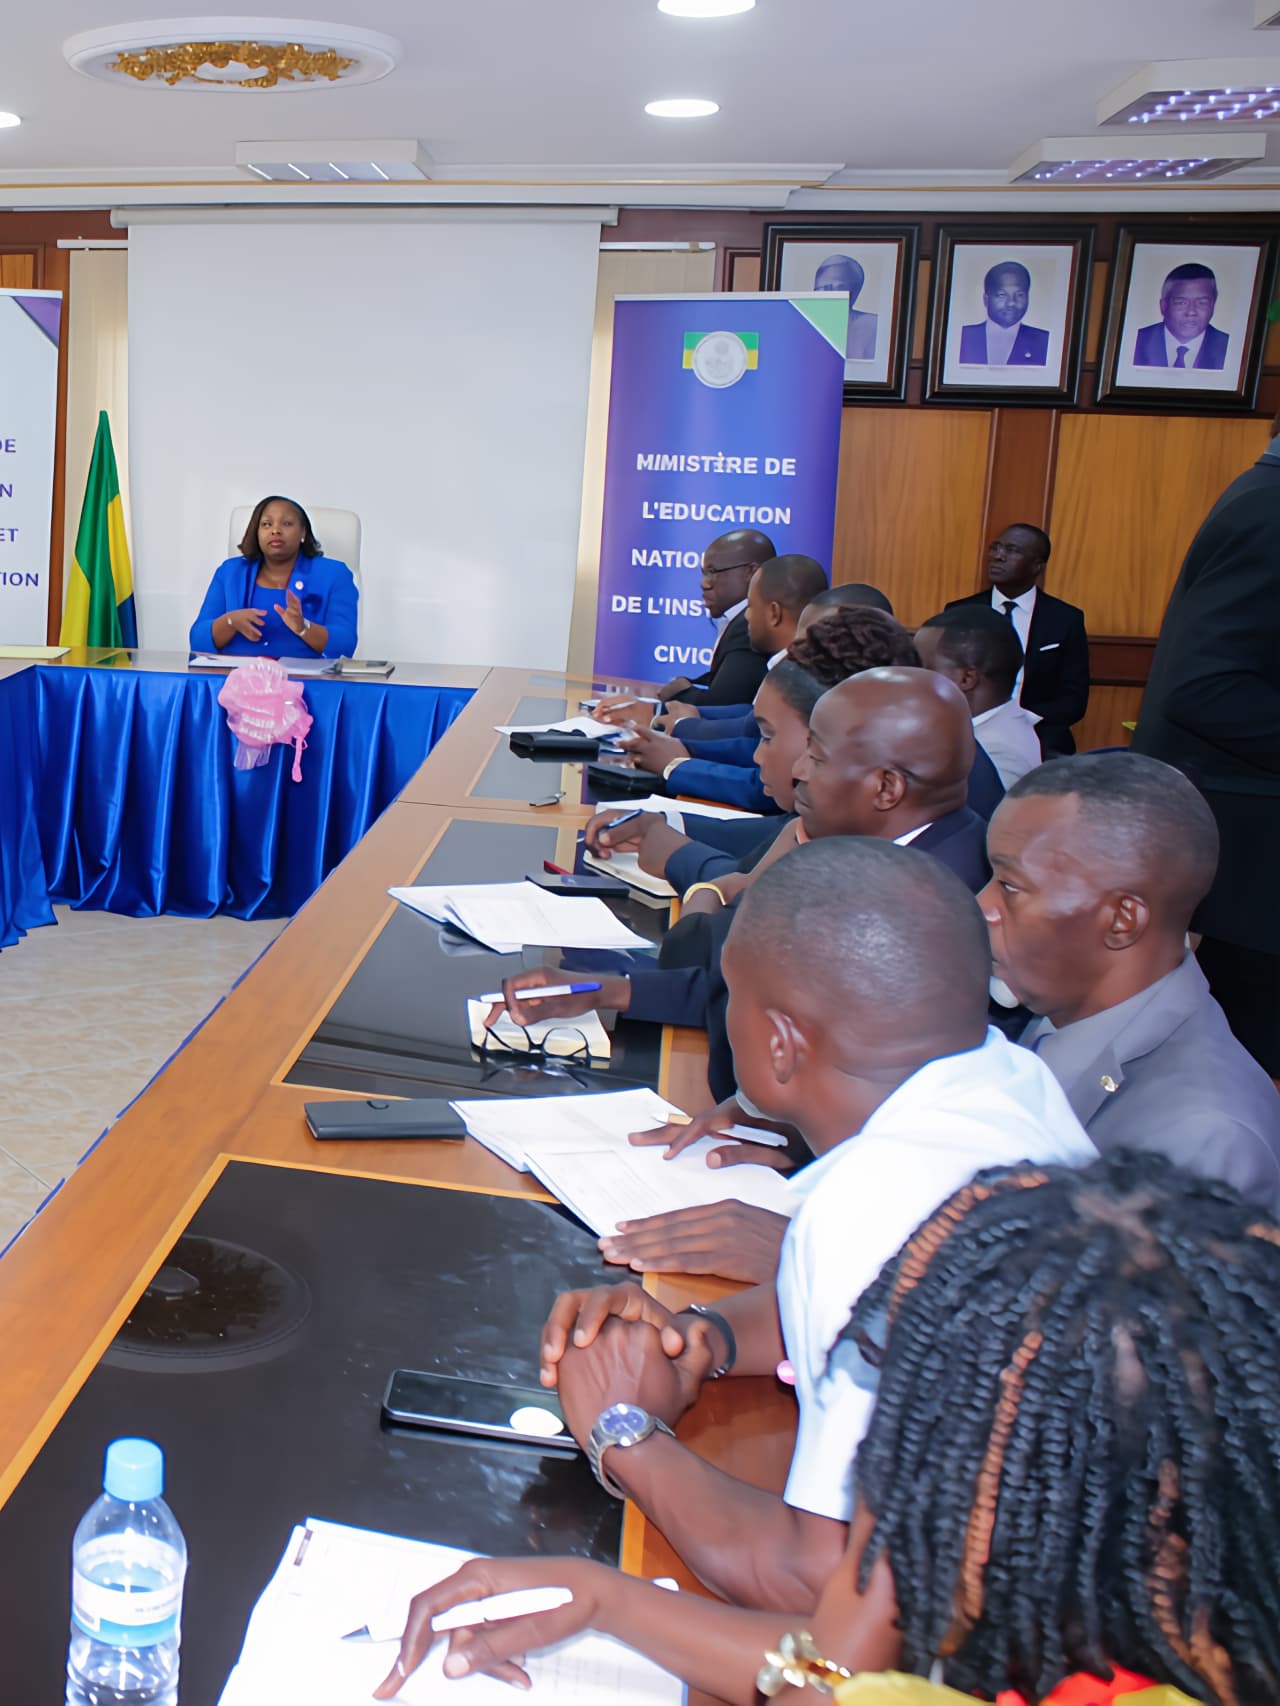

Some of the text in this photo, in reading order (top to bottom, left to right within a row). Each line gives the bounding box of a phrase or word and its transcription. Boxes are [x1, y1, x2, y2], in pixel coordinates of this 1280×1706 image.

[764, 458, 797, 476] DE
[642, 501, 791, 525] L'EDUCATION
[631, 549, 704, 568] NATIO
[611, 595, 642, 613] DE
